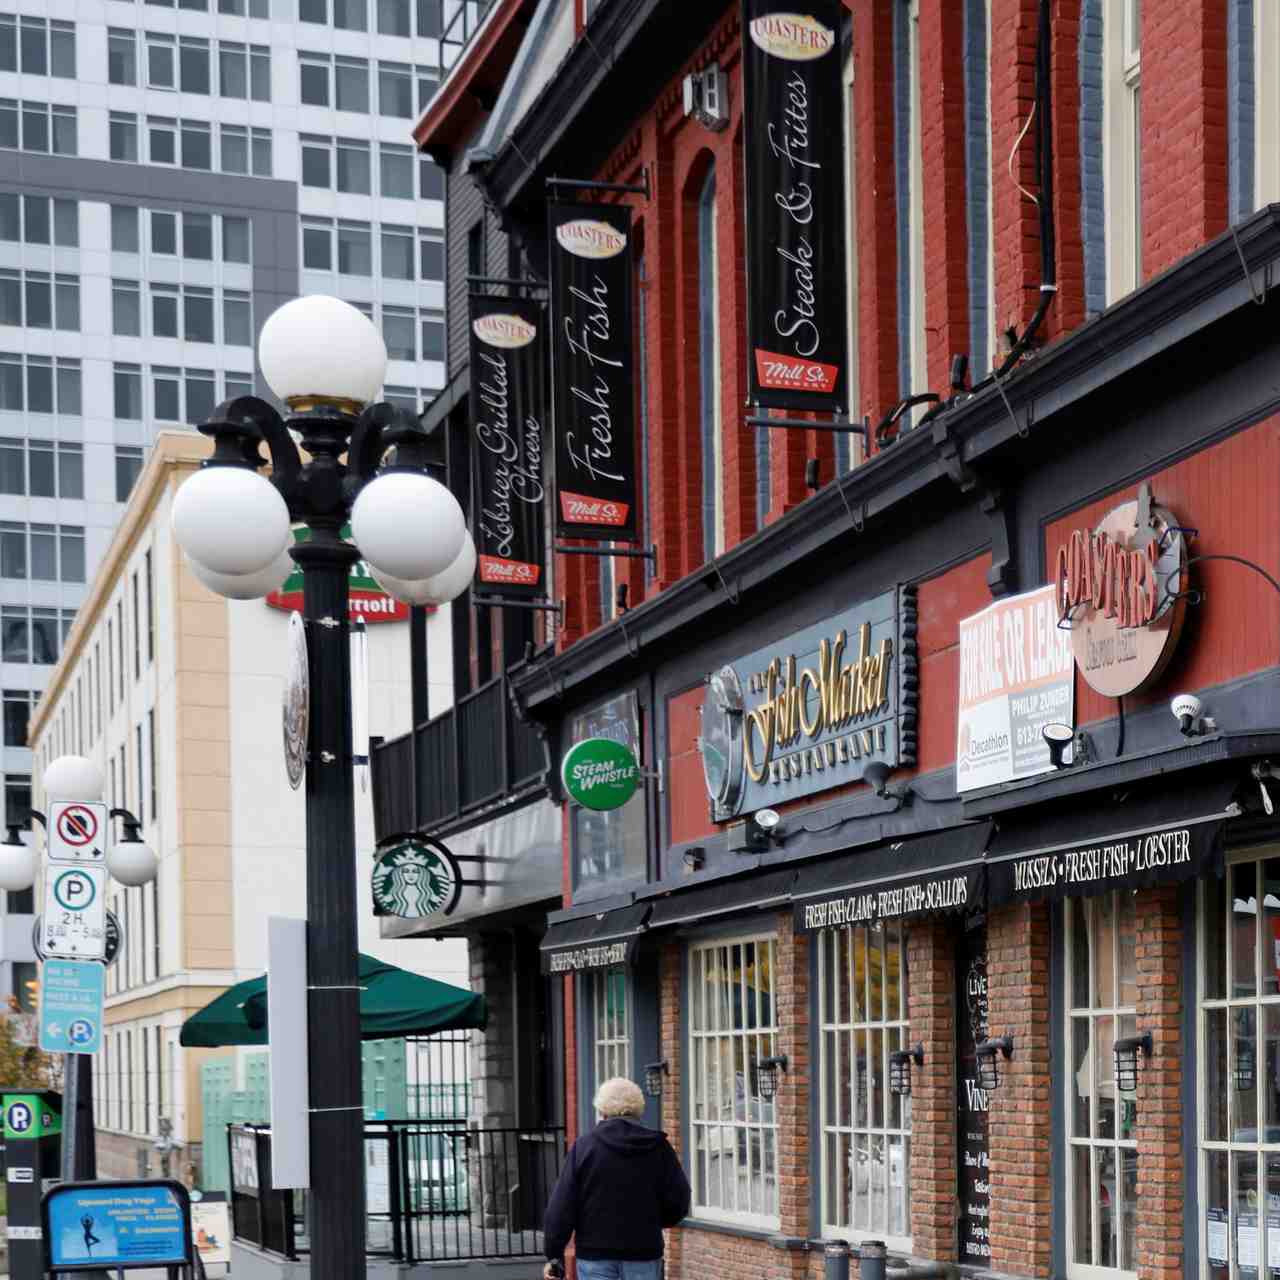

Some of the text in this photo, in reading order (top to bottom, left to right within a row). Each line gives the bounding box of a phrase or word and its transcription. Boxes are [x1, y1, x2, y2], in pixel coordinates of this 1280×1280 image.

[767, 71, 821, 169] Frites
[563, 273, 624, 368] Fish
[774, 236, 820, 356] Steak
[475, 353, 519, 463] Grilled
[762, 361, 804, 381] Mill
[510, 415, 545, 504] Cheese
[565, 375, 626, 482] Fresh
[1056, 529, 1160, 628] COASTERS
[799, 622, 893, 738] Market
[572, 760, 615, 780] STEAM
[877, 887, 903, 918] FRESH
[925, 876, 968, 910] SCALLOPS
[1014, 855, 1058, 891] MUSSELS
[1064, 849, 1100, 884] FRESH
[1102, 843, 1129, 879] FISH
